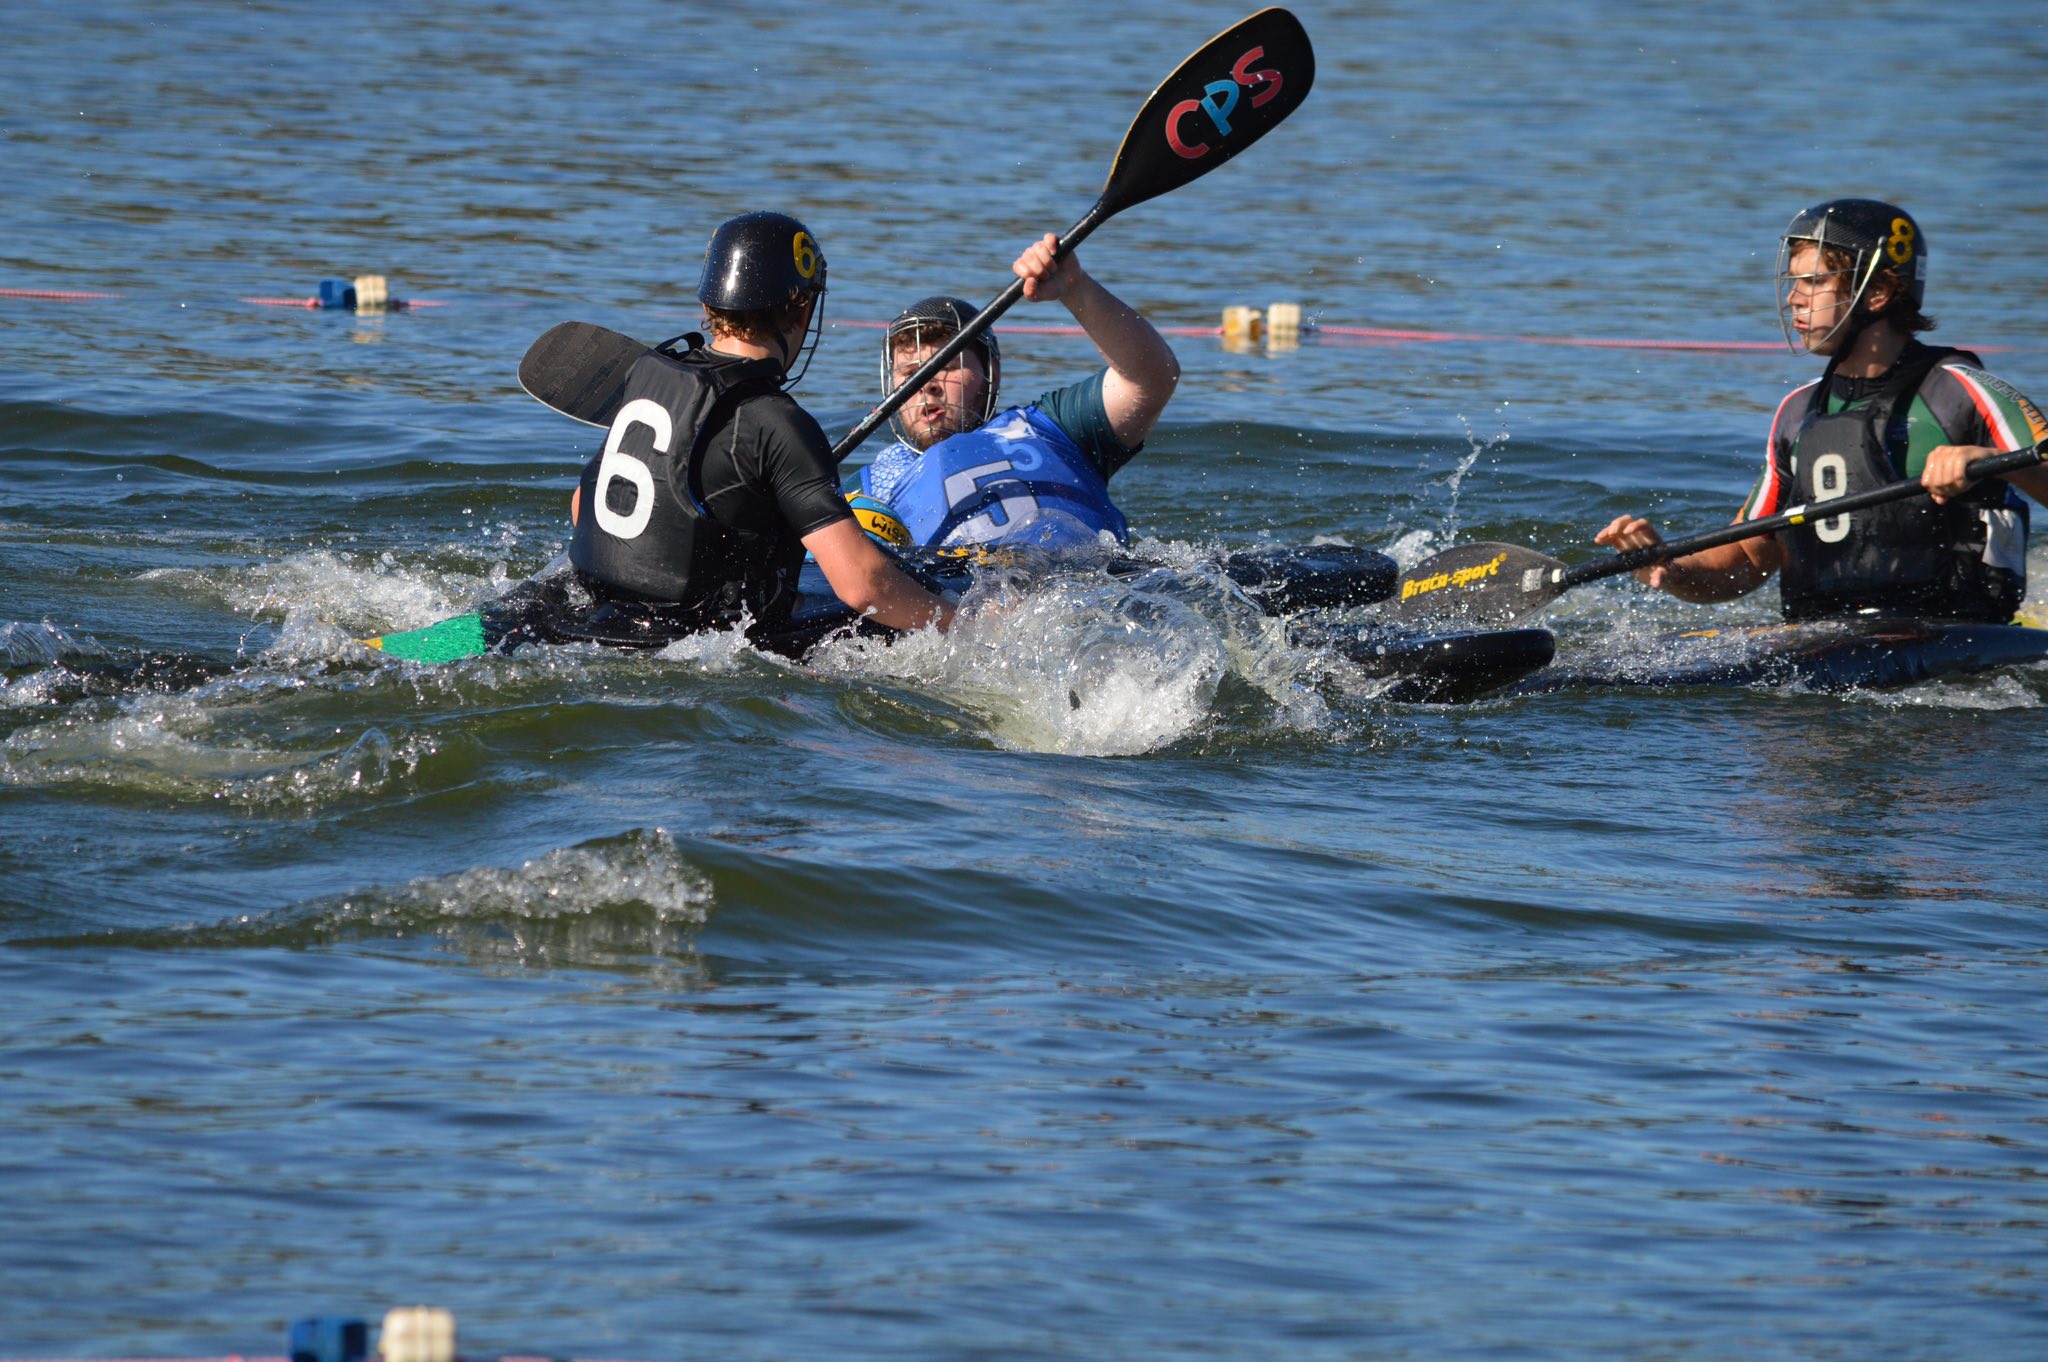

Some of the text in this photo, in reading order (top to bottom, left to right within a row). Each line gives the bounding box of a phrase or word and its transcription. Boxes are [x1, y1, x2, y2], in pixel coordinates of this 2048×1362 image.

[1165, 45, 1283, 160] CPS
[793, 231, 816, 280] 6
[1887, 218, 1915, 264] 8
[594, 398, 673, 540] 6
[943, 459, 1040, 546] 5
[1812, 453, 1851, 544] 8
